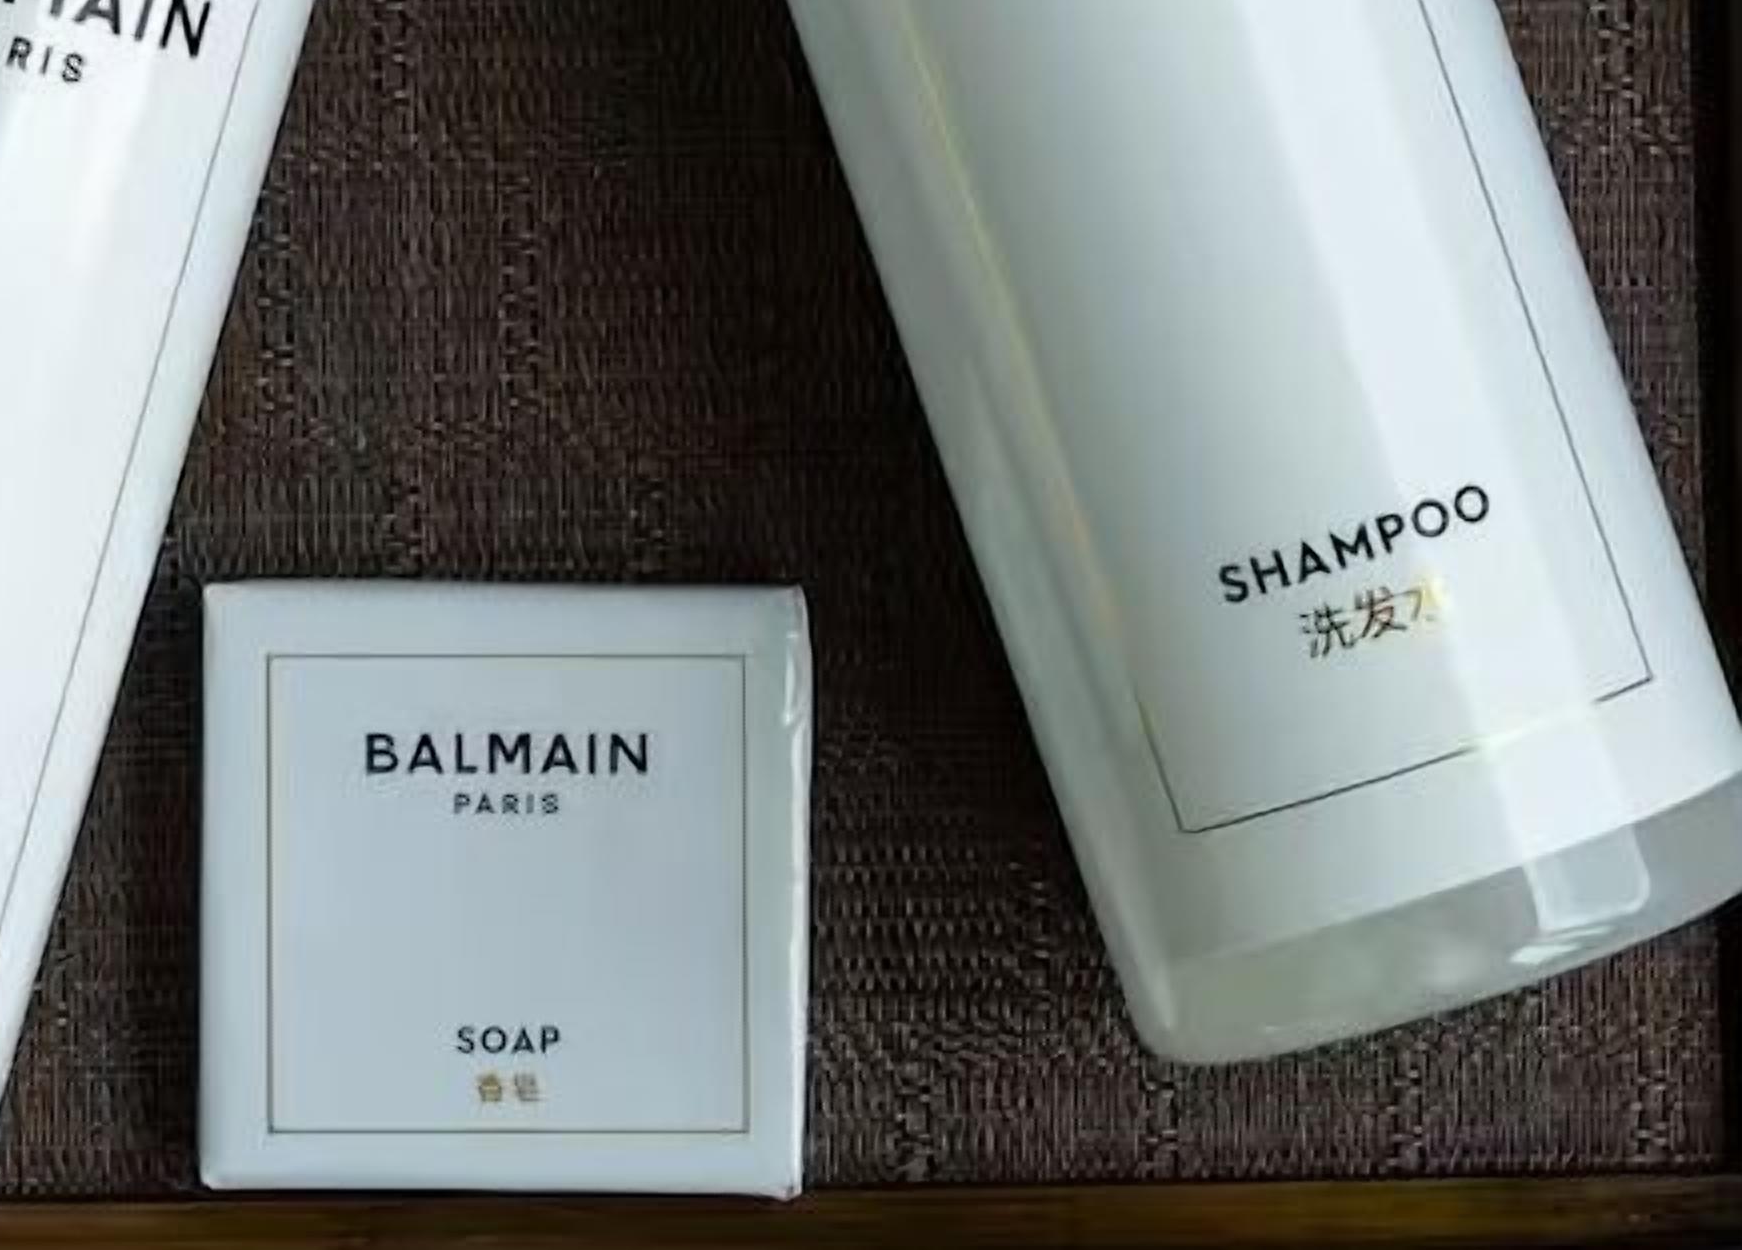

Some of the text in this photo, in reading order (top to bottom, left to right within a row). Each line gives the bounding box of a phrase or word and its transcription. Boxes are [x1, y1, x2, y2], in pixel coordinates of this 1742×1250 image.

[1218, 485, 1490, 603] SHAMPOO
[365, 732, 649, 775] BALMAIN
[453, 793, 560, 815] PARIS
[457, 1025, 561, 1055] SOAP
